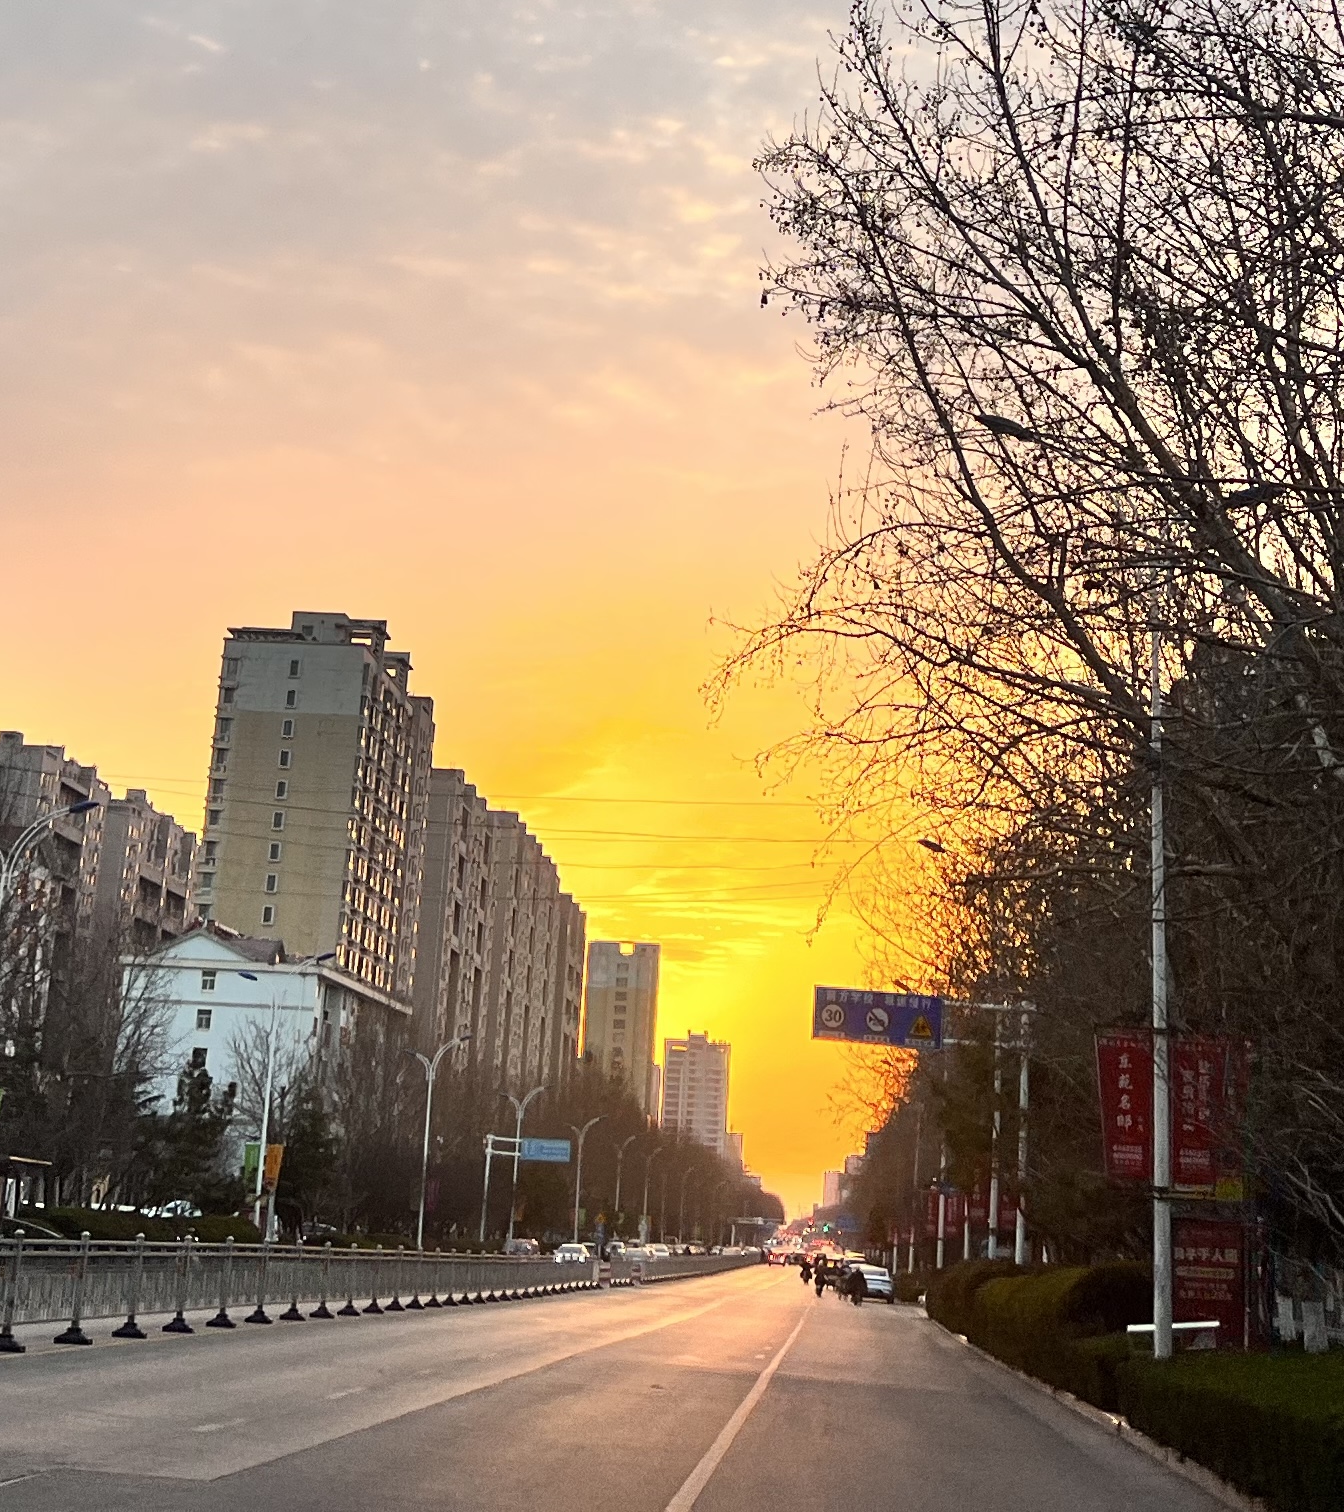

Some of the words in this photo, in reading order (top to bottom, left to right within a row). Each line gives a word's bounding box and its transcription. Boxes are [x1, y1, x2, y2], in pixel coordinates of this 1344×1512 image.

[825, 990, 874, 1005] 前方学校
[884, 994, 932, 1011] 减速慢行
[824, 1009, 842, 1023] 30
